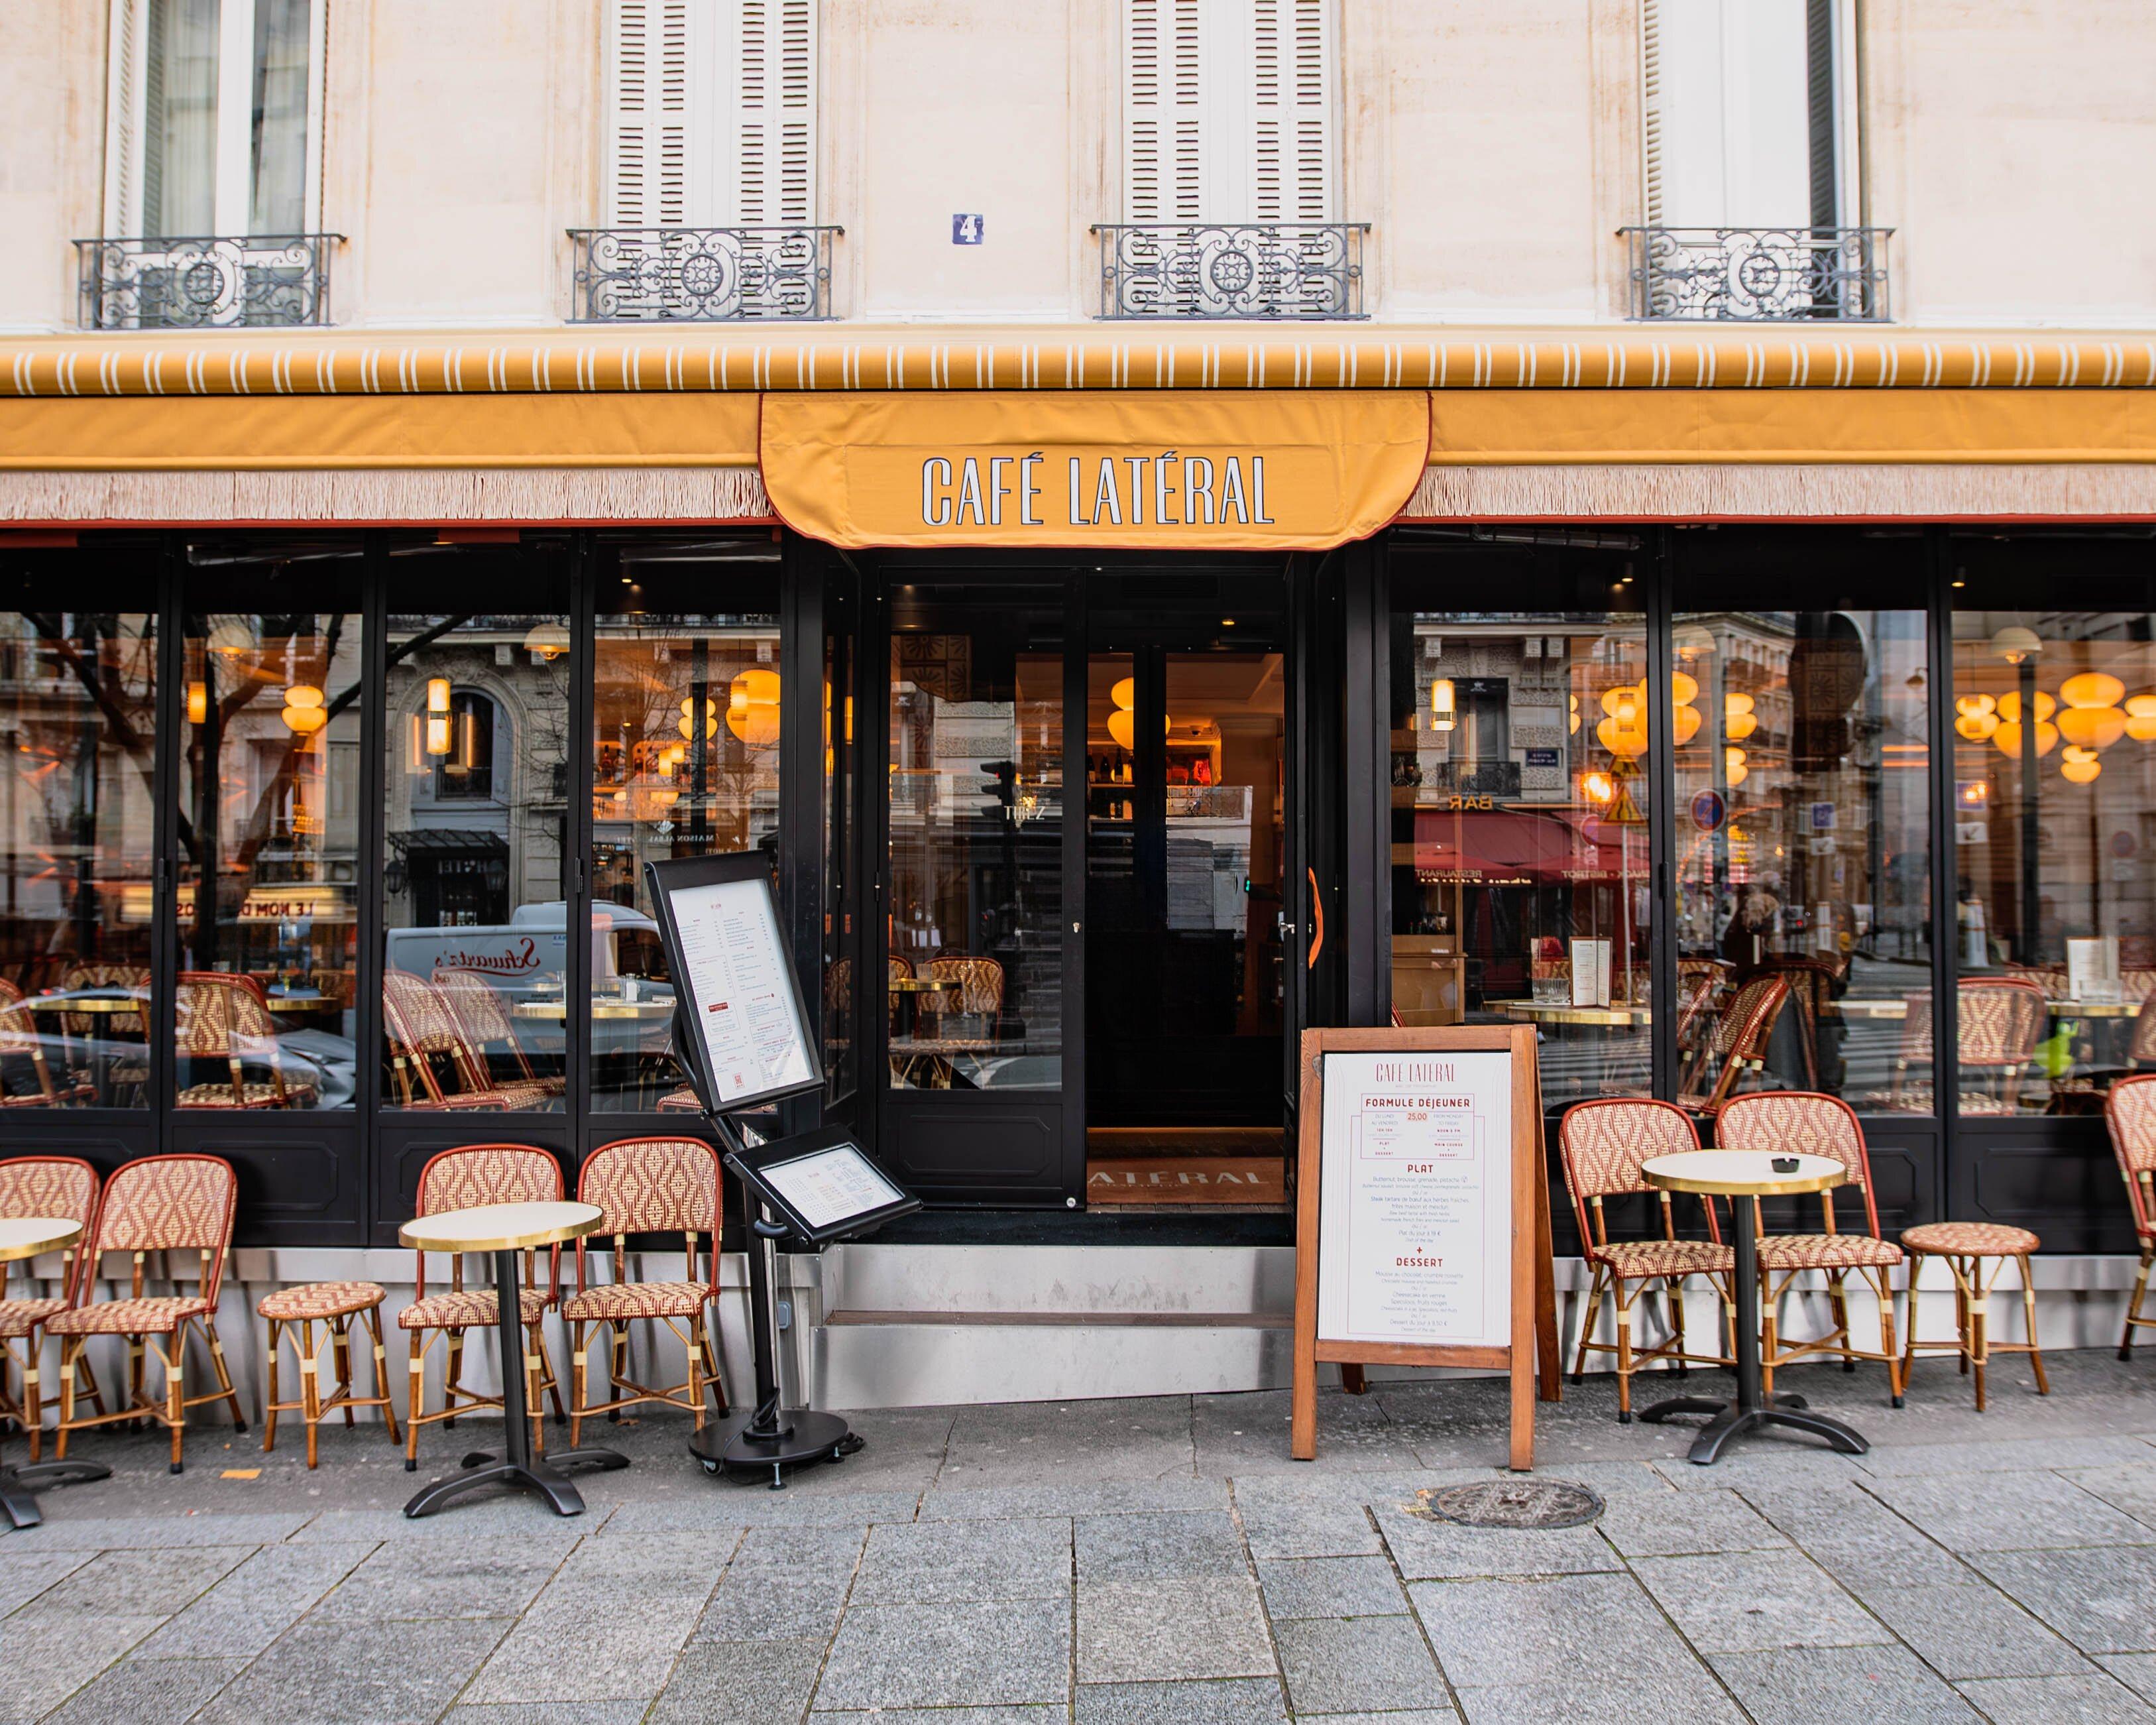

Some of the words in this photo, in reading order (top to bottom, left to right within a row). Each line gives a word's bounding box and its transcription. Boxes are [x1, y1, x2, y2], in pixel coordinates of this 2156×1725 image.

[958, 215, 978, 243] 4
[921, 451, 1045, 526] CAFÉ
[1068, 451, 1275, 525] LATÉRAL
[1376, 1061, 1403, 1082] CAFÉ
[1366, 1099, 1414, 1107] FORMULE
[1418, 1097, 1470, 1109] DÉJEUNER
[1088, 1171, 1270, 1184] ATÉRAL
[1396, 1258, 1443, 1267] DESSERT
